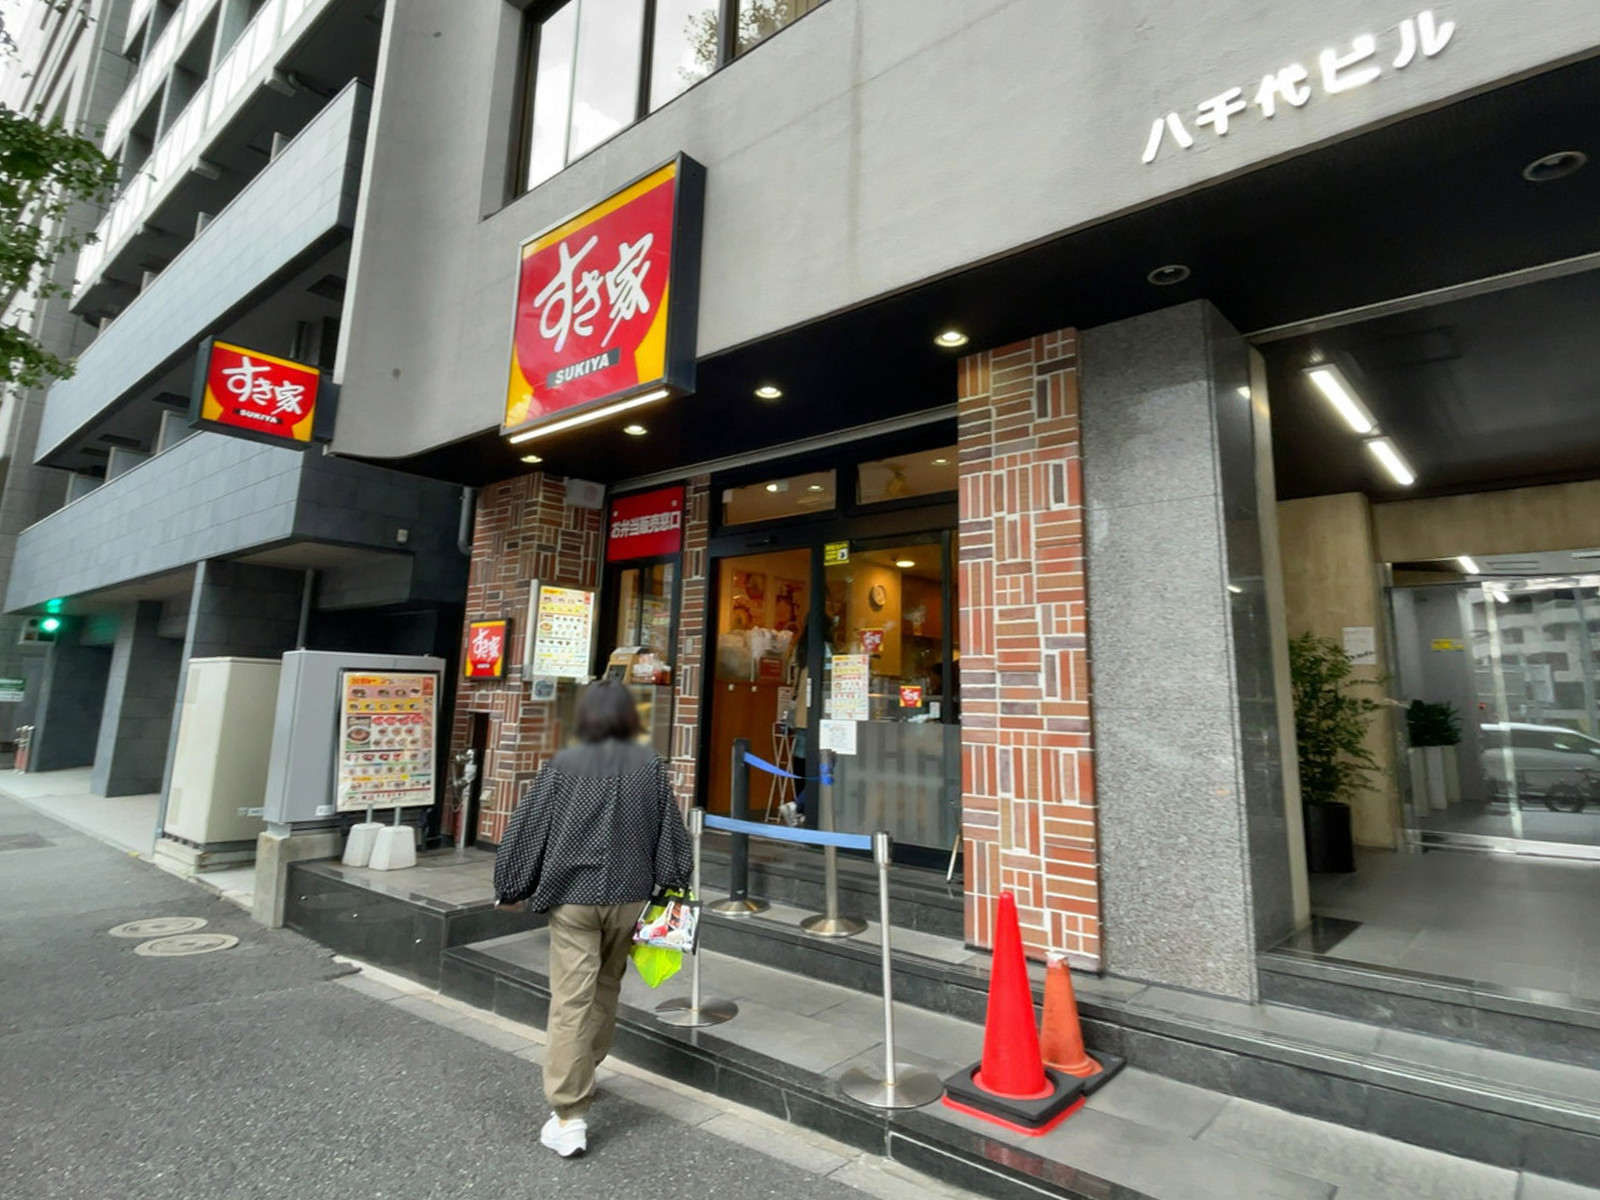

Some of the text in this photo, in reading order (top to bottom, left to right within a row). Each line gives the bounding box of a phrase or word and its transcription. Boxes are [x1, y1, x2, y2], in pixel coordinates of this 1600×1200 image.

[1141, 10, 1456, 164] 八千代ビル
[533, 232, 654, 353] すき家
[222, 356, 305, 415] すき家
[554, 353, 611, 385] SUKIYA
